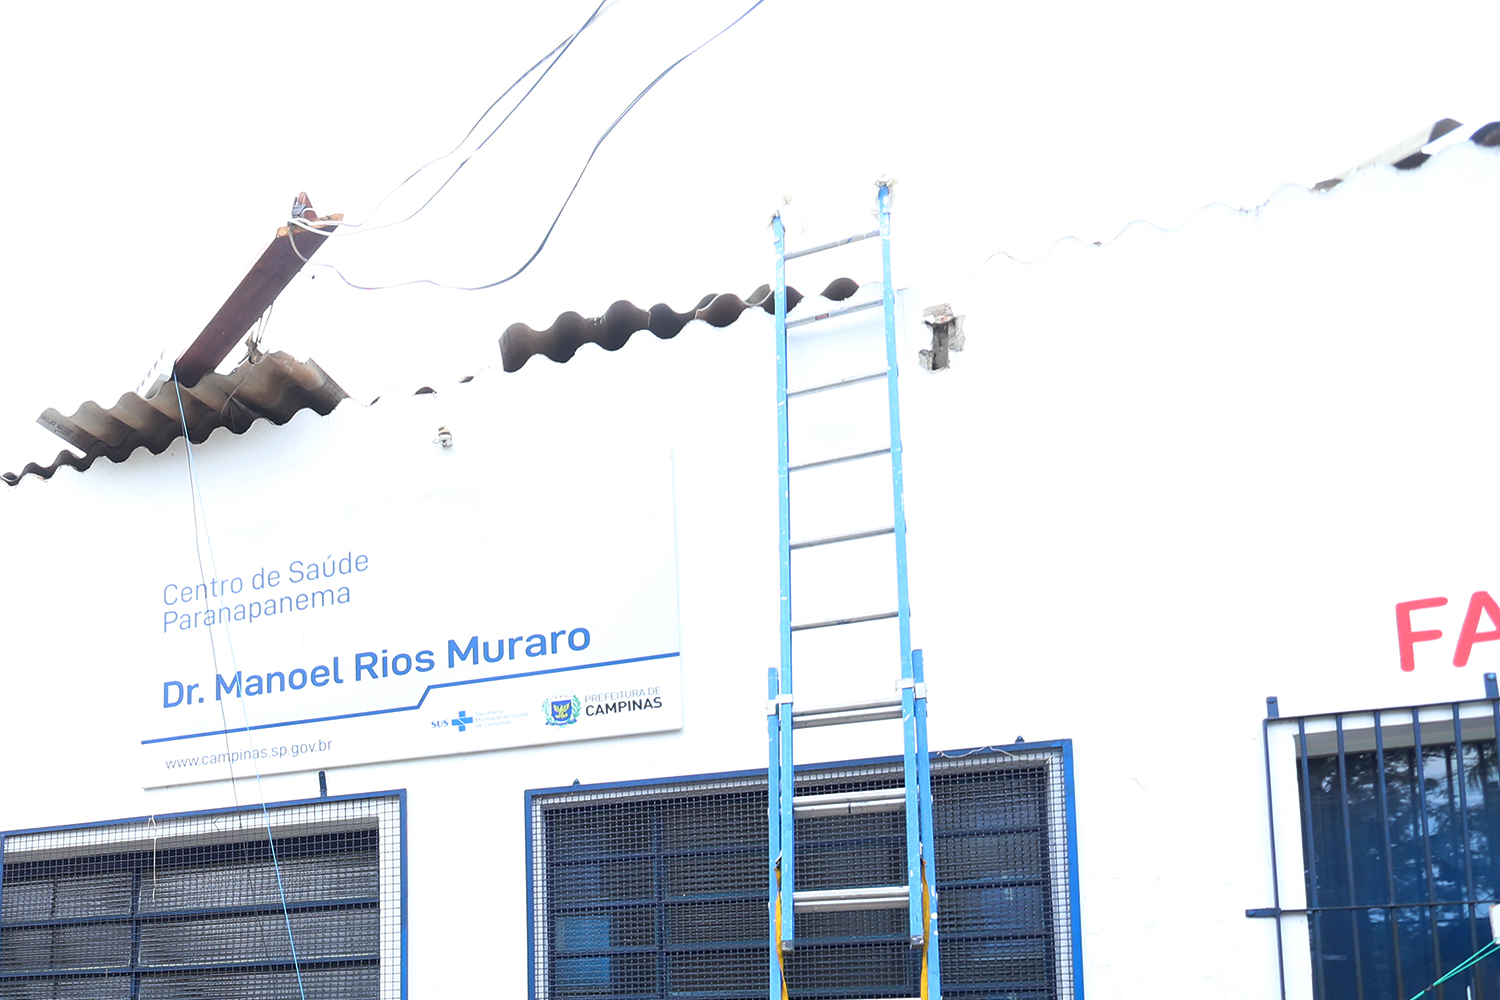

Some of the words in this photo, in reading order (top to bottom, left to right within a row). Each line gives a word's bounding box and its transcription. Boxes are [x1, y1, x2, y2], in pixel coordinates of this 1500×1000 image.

[163, 576, 243, 606] Centro
[252, 567, 280, 590] de
[289, 551, 369, 584] Saúde
[163, 586, 351, 633] Paranapanema
[1395, 590, 1500, 672] FA
[163, 680, 204, 709] Dr.
[215, 656, 344, 701] Manoel
[355, 649, 436, 682] Rios
[447, 627, 591, 669] Muraro
[584, 688, 646, 703] PREFEITURA
[647, 686, 661, 696] DE
[585, 696, 663, 717] CAMPINAS
[430, 719, 449, 729] SUS
[165, 739, 333, 769] www.campinas.sp.gov.br
